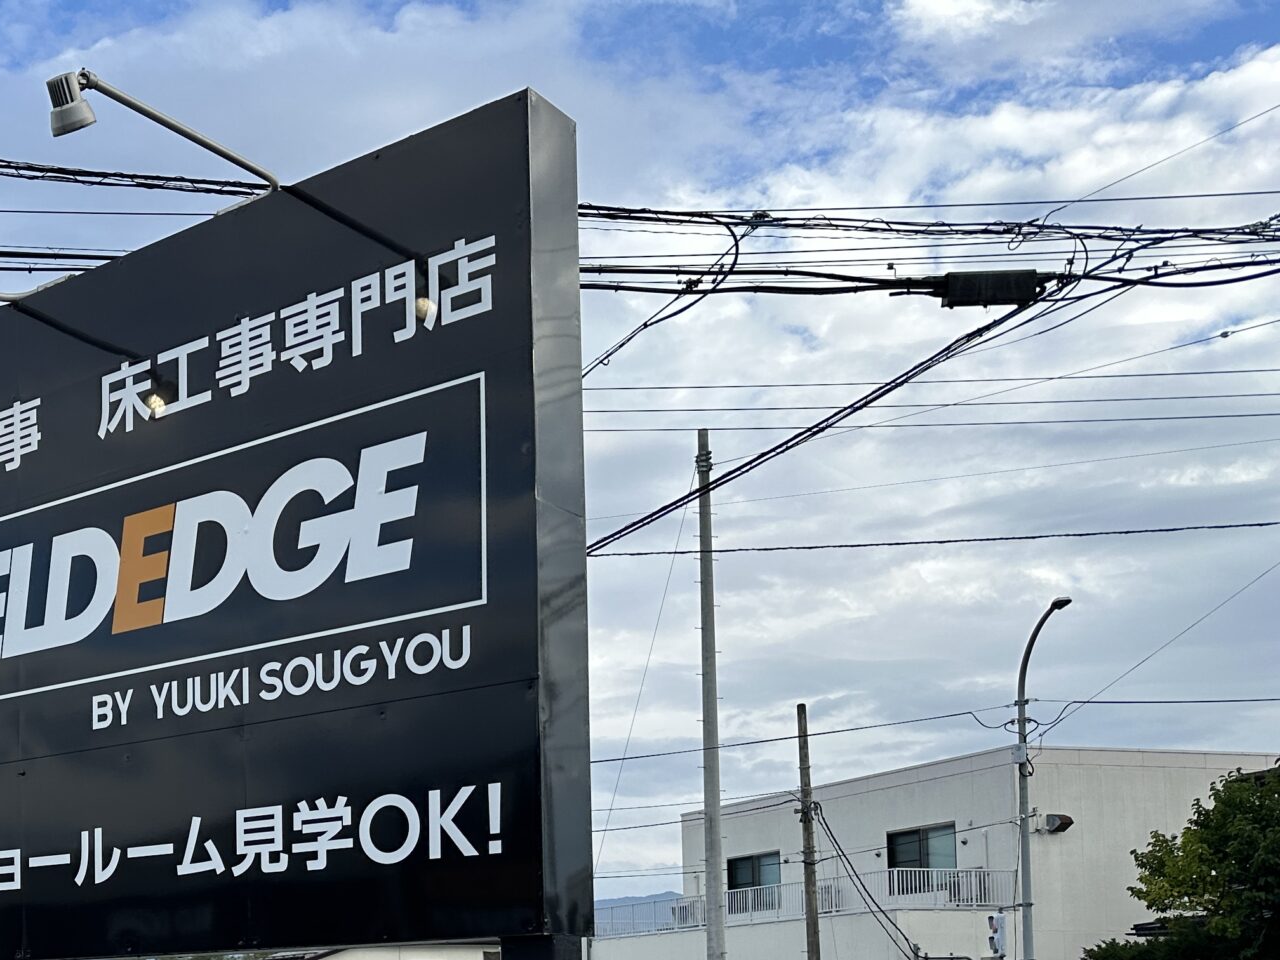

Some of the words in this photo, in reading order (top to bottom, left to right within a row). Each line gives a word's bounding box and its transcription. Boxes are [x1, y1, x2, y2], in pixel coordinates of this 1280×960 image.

[96, 234, 497, 440] 床工事専門店
[91, 688, 133, 731] BY
[149, 661, 251, 721] YUUKI
[258, 624, 473, 703] SOUGYOU
